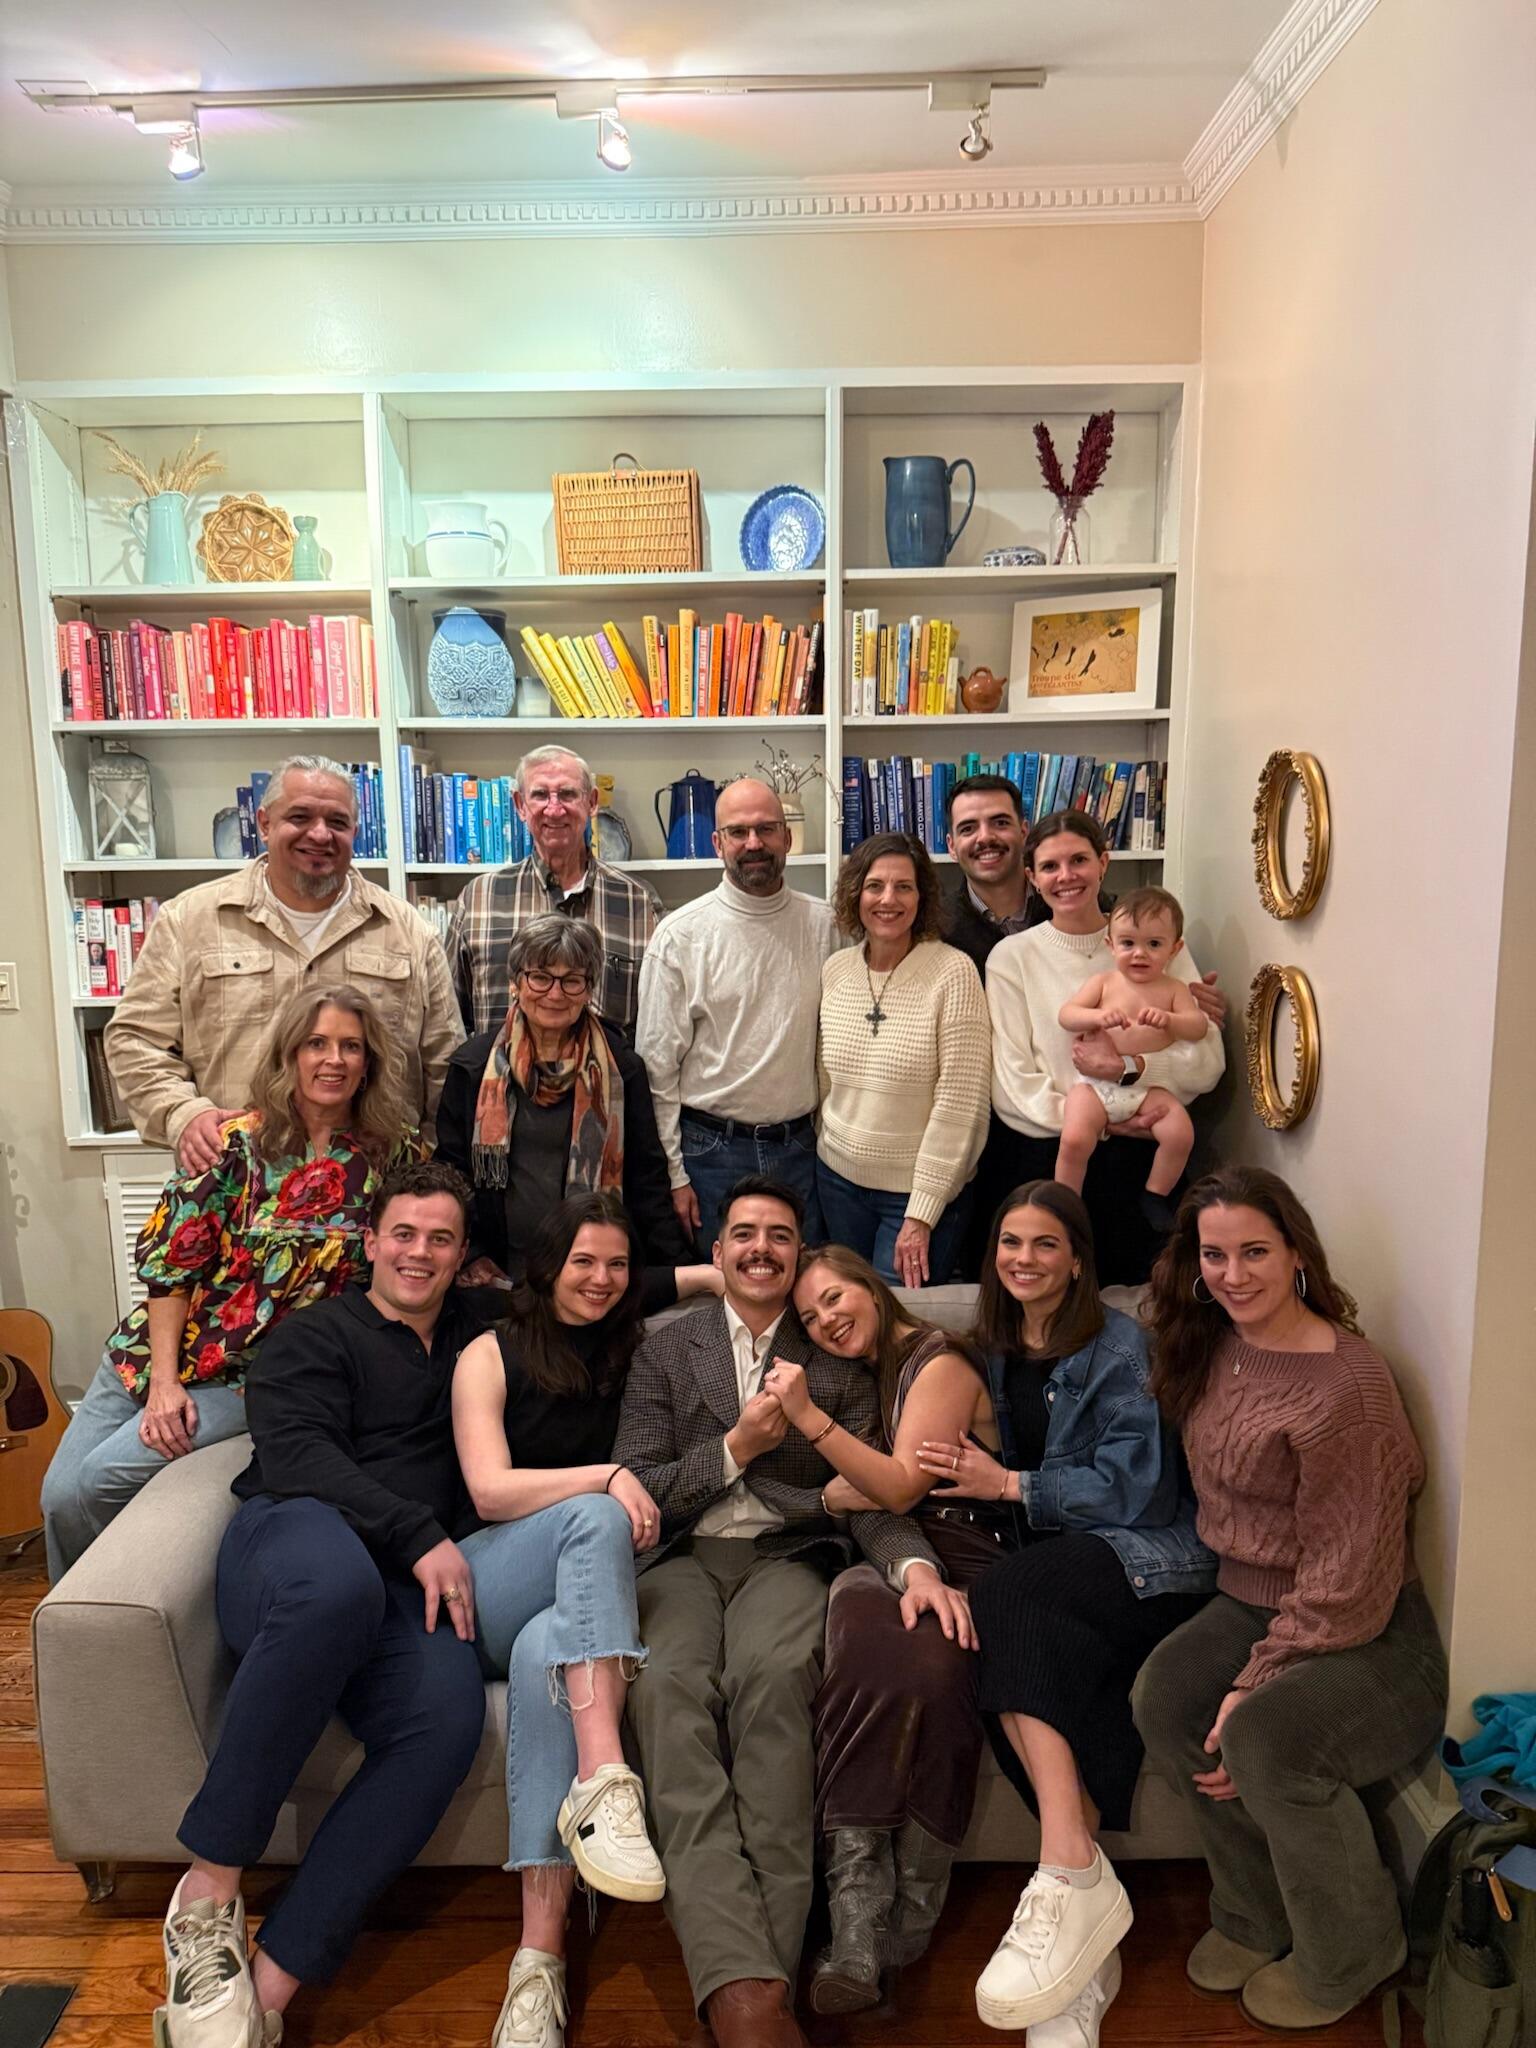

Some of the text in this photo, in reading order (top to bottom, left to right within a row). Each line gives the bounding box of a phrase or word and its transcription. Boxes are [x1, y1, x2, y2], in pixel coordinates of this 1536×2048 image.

[70, 625, 81, 665] HAPPY PLACE
[854, 638, 862, 658] THE
[854, 660, 862, 680] DAY
[1031, 672, 1077, 683] Troupe de
[72, 670, 84, 710] EMILY HENRY
[467, 800, 476, 837] Thailand
[872, 801, 880, 822] MAYO
